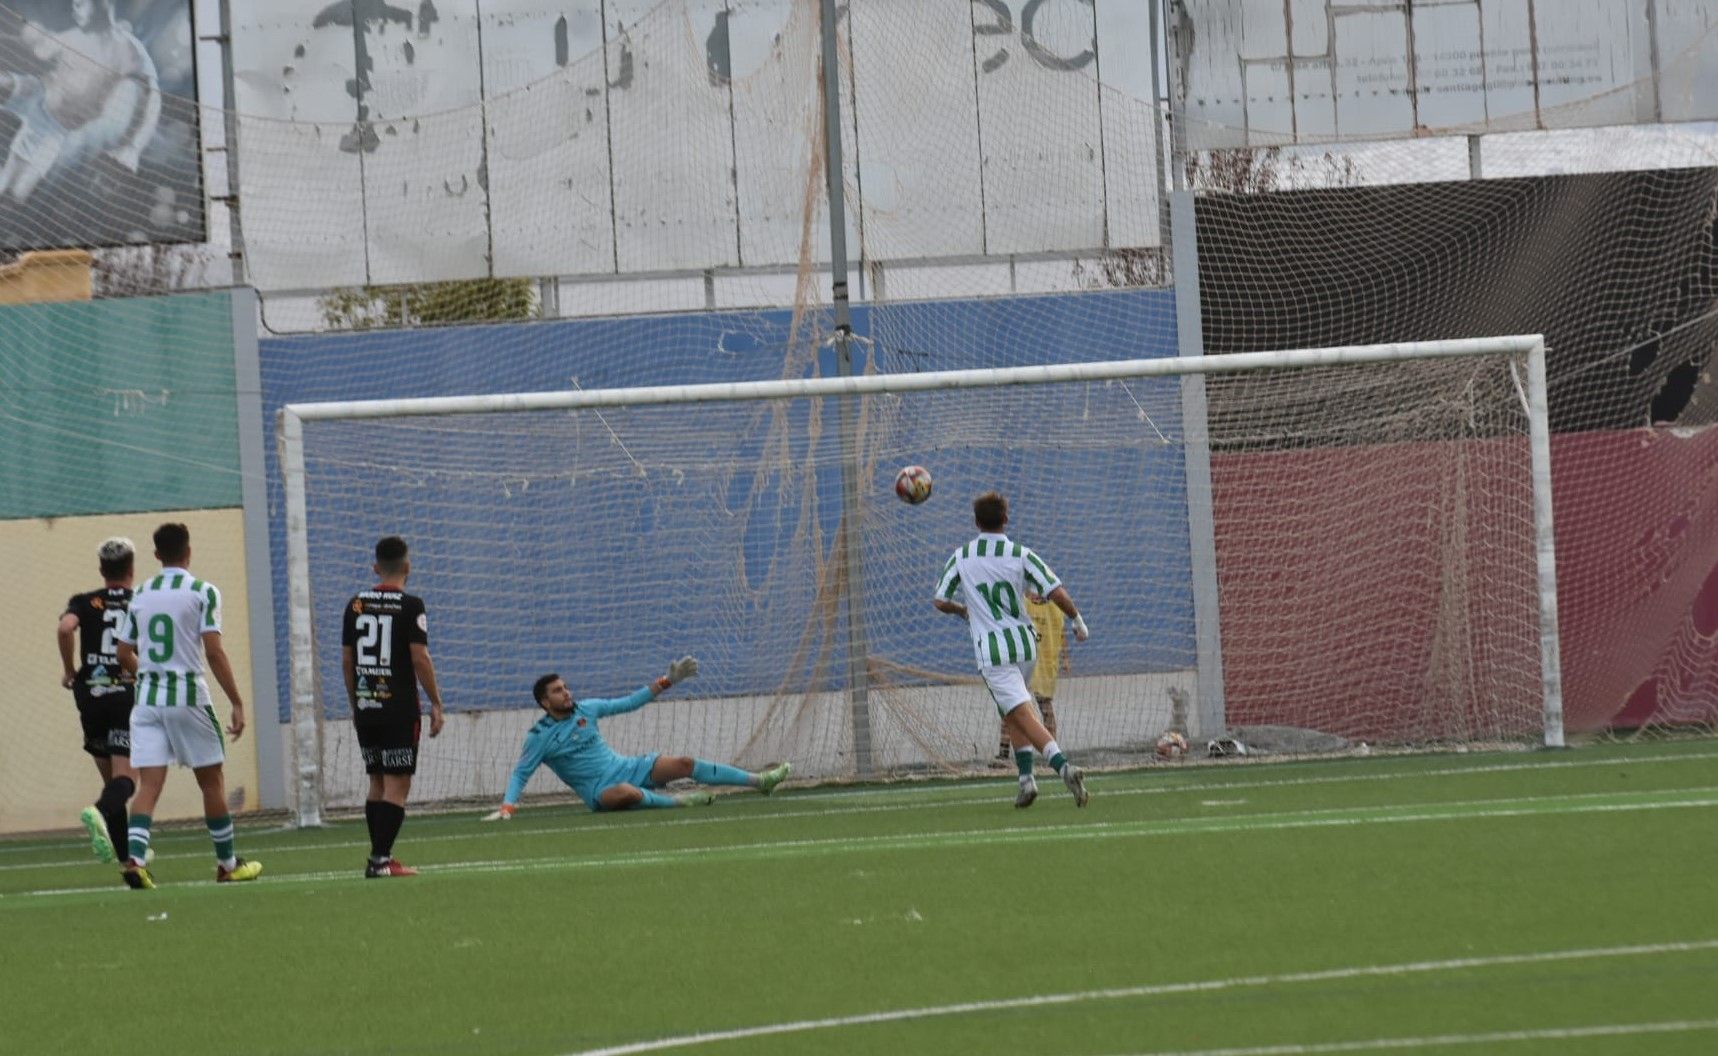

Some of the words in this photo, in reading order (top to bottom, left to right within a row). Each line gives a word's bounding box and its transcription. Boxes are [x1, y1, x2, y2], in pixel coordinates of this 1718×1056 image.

[975, 580, 1020, 621] 10
[148, 613, 174, 664] 9
[355, 613, 393, 667] 21
